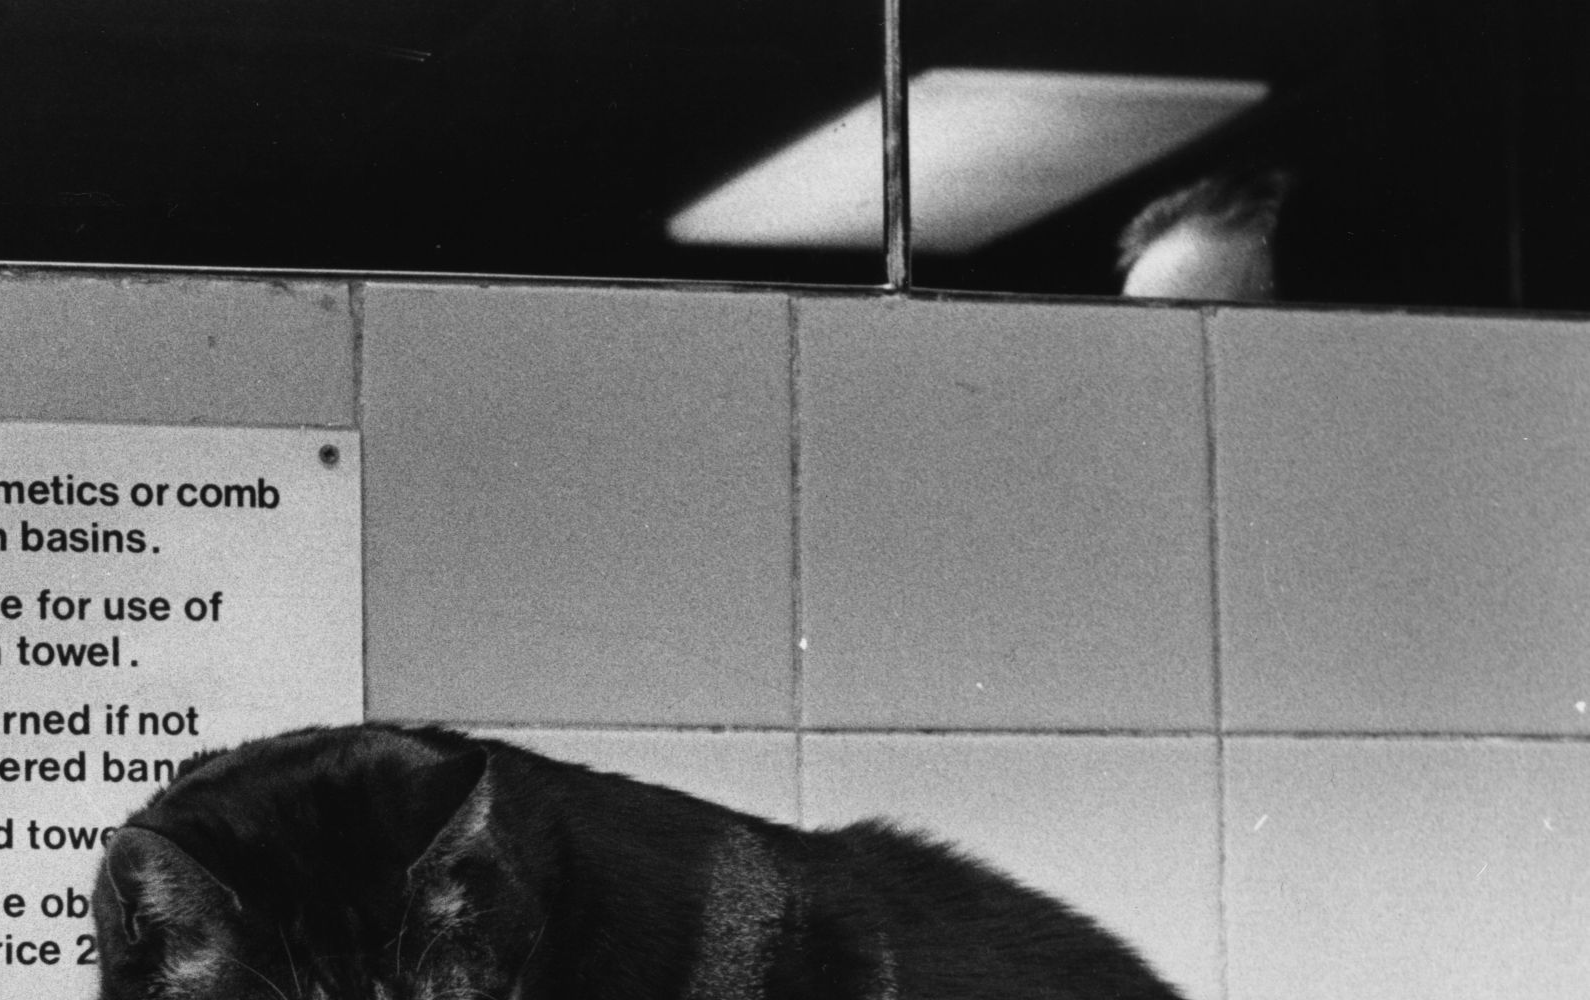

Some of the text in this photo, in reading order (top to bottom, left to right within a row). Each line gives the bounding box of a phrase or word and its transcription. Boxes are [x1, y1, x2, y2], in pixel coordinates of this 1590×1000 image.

[130, 483, 170, 508] or
[177, 478, 280, 510] comb
[20, 521, 160, 554] basins.
[37, 589, 91, 621] for
[103, 598, 171, 622] use
[184, 592, 222, 622] of
[17, 637, 138, 668] towel.
[105, 705, 129, 735] if
[138, 707, 198, 736] not
[41, 887, 90, 919] ob
[76, 934, 98, 965] 2
